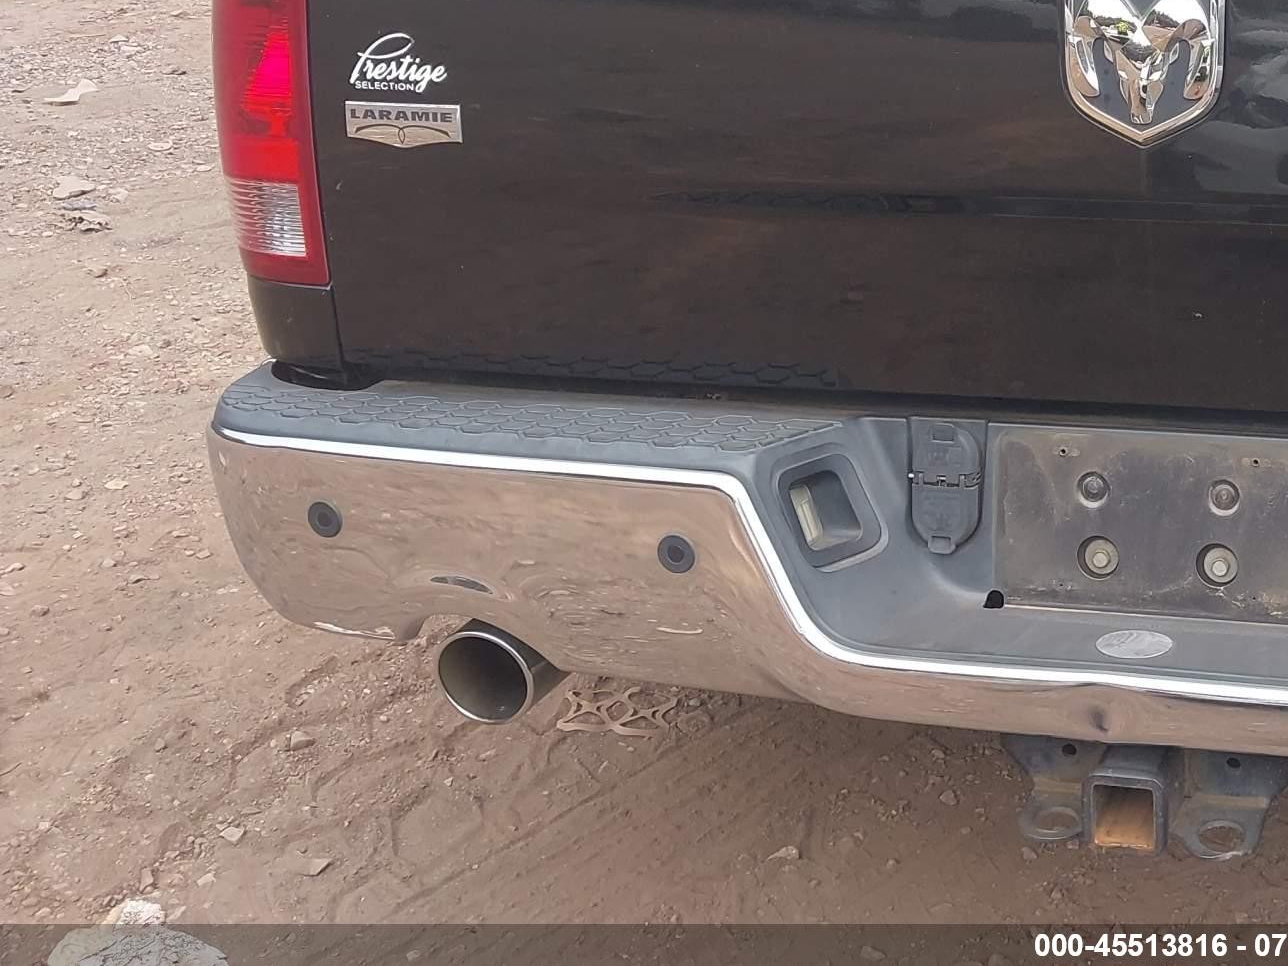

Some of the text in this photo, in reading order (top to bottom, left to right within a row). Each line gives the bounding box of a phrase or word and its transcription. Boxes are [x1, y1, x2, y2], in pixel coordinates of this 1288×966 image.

[349, 32, 448, 93] Prestige
[354, 80, 415, 92] SELECTION
[349, 108, 453, 123] LARAMIE
